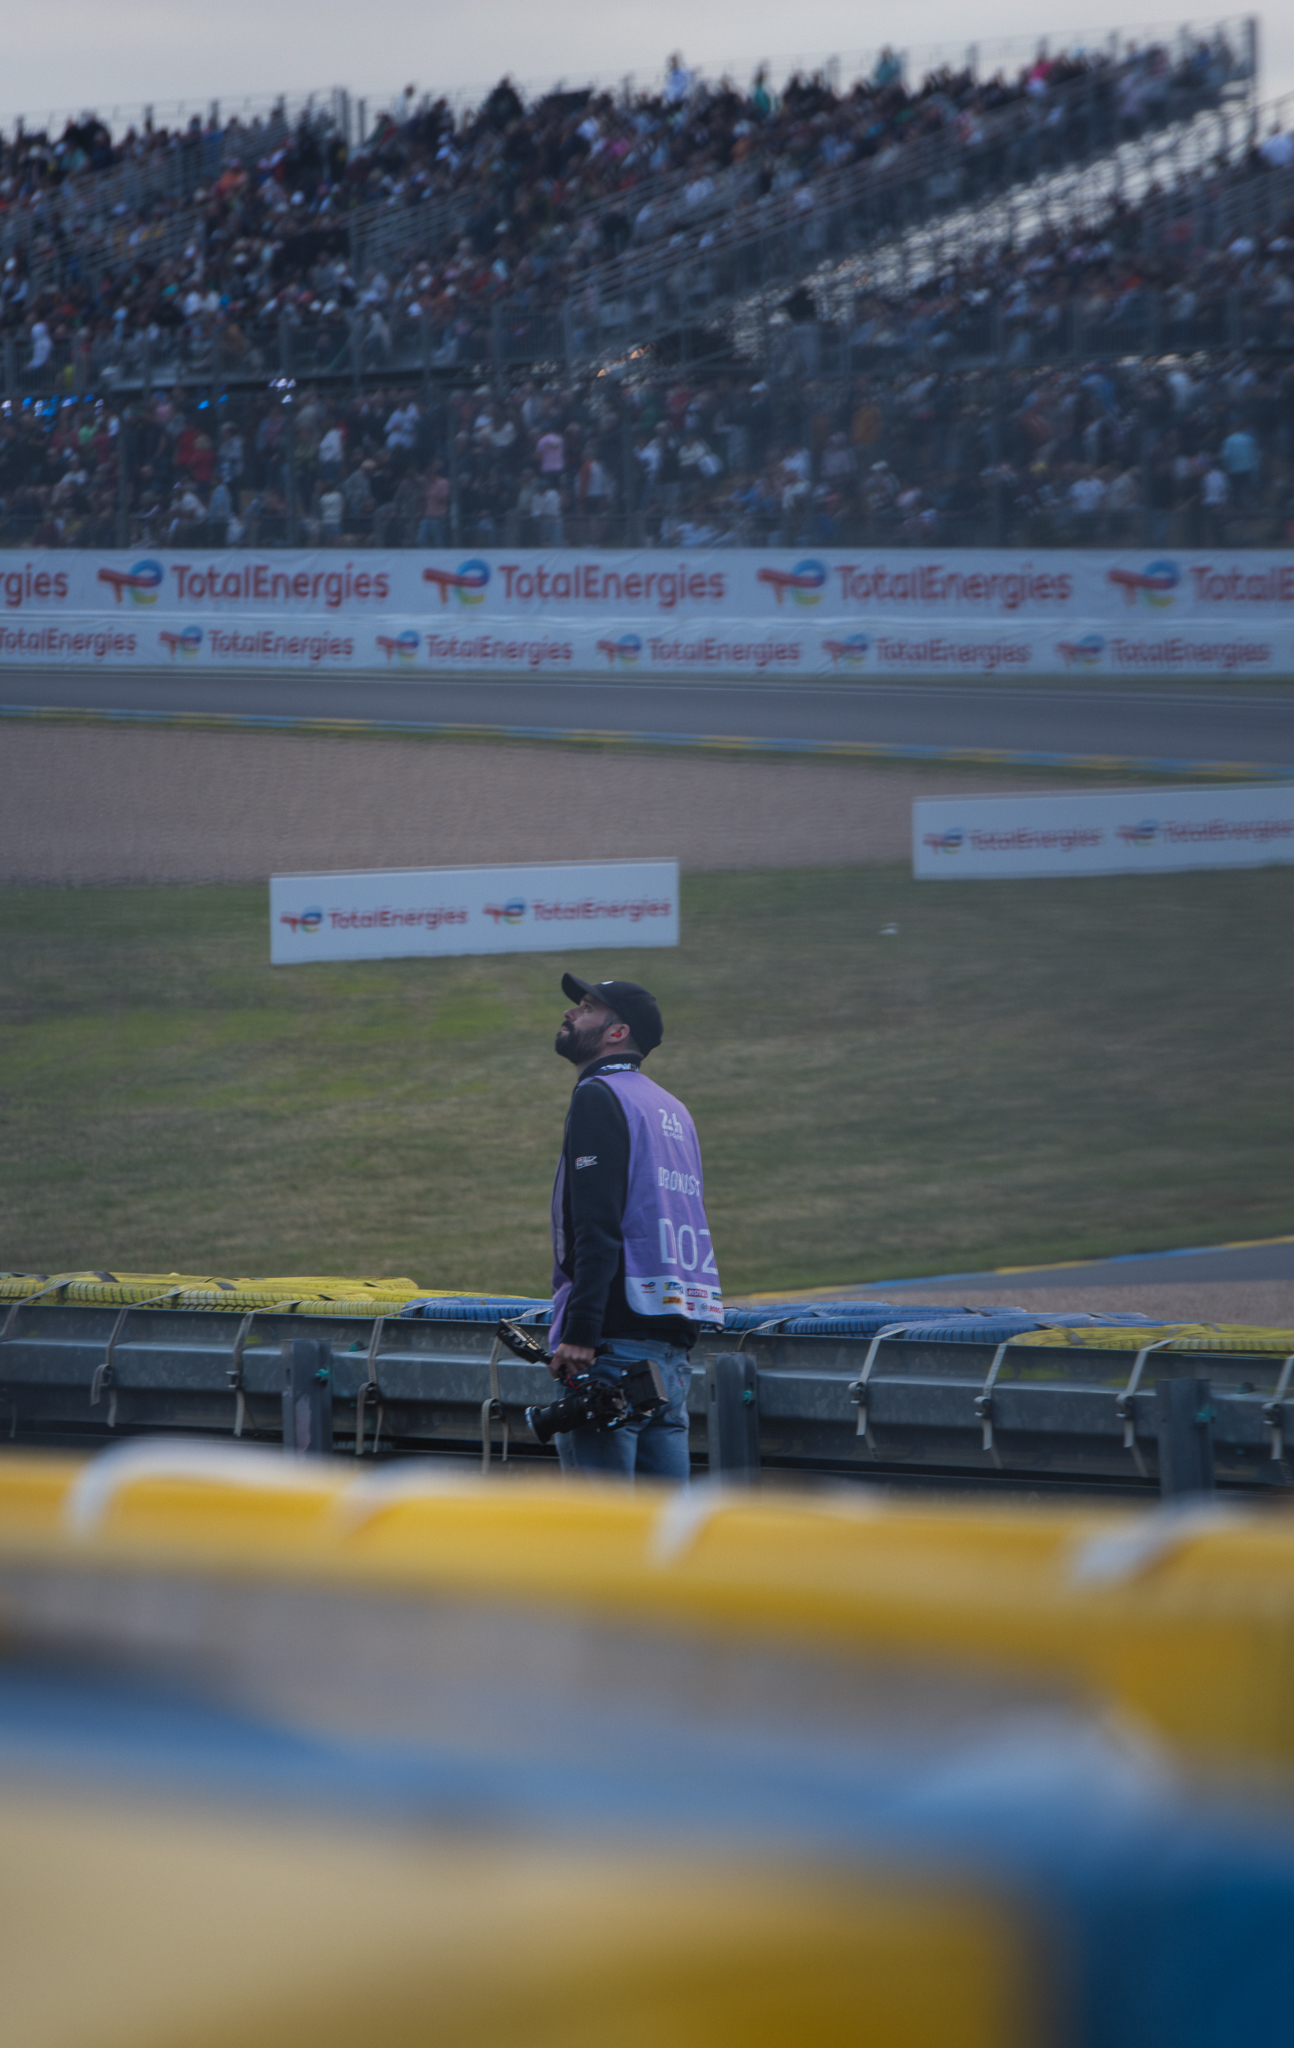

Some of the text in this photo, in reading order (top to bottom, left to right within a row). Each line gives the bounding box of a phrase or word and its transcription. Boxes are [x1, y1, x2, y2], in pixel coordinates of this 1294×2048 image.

[170, 563, 390, 609] TotalEnergies
[498, 564, 726, 610] TotalEnergies
[834, 564, 1073, 611] TotalEnergies
[208, 629, 355, 663] TotalEnergies
[425, 634, 574, 667] TotalEnergies
[647, 637, 802, 668] TotalEnergies
[874, 636, 1032, 671] TotalEnergies
[1109, 637, 1272, 670] TotalEnergies
[327, 905, 468, 930] TotalEnergies
[531, 897, 672, 923] TotalEnergies
